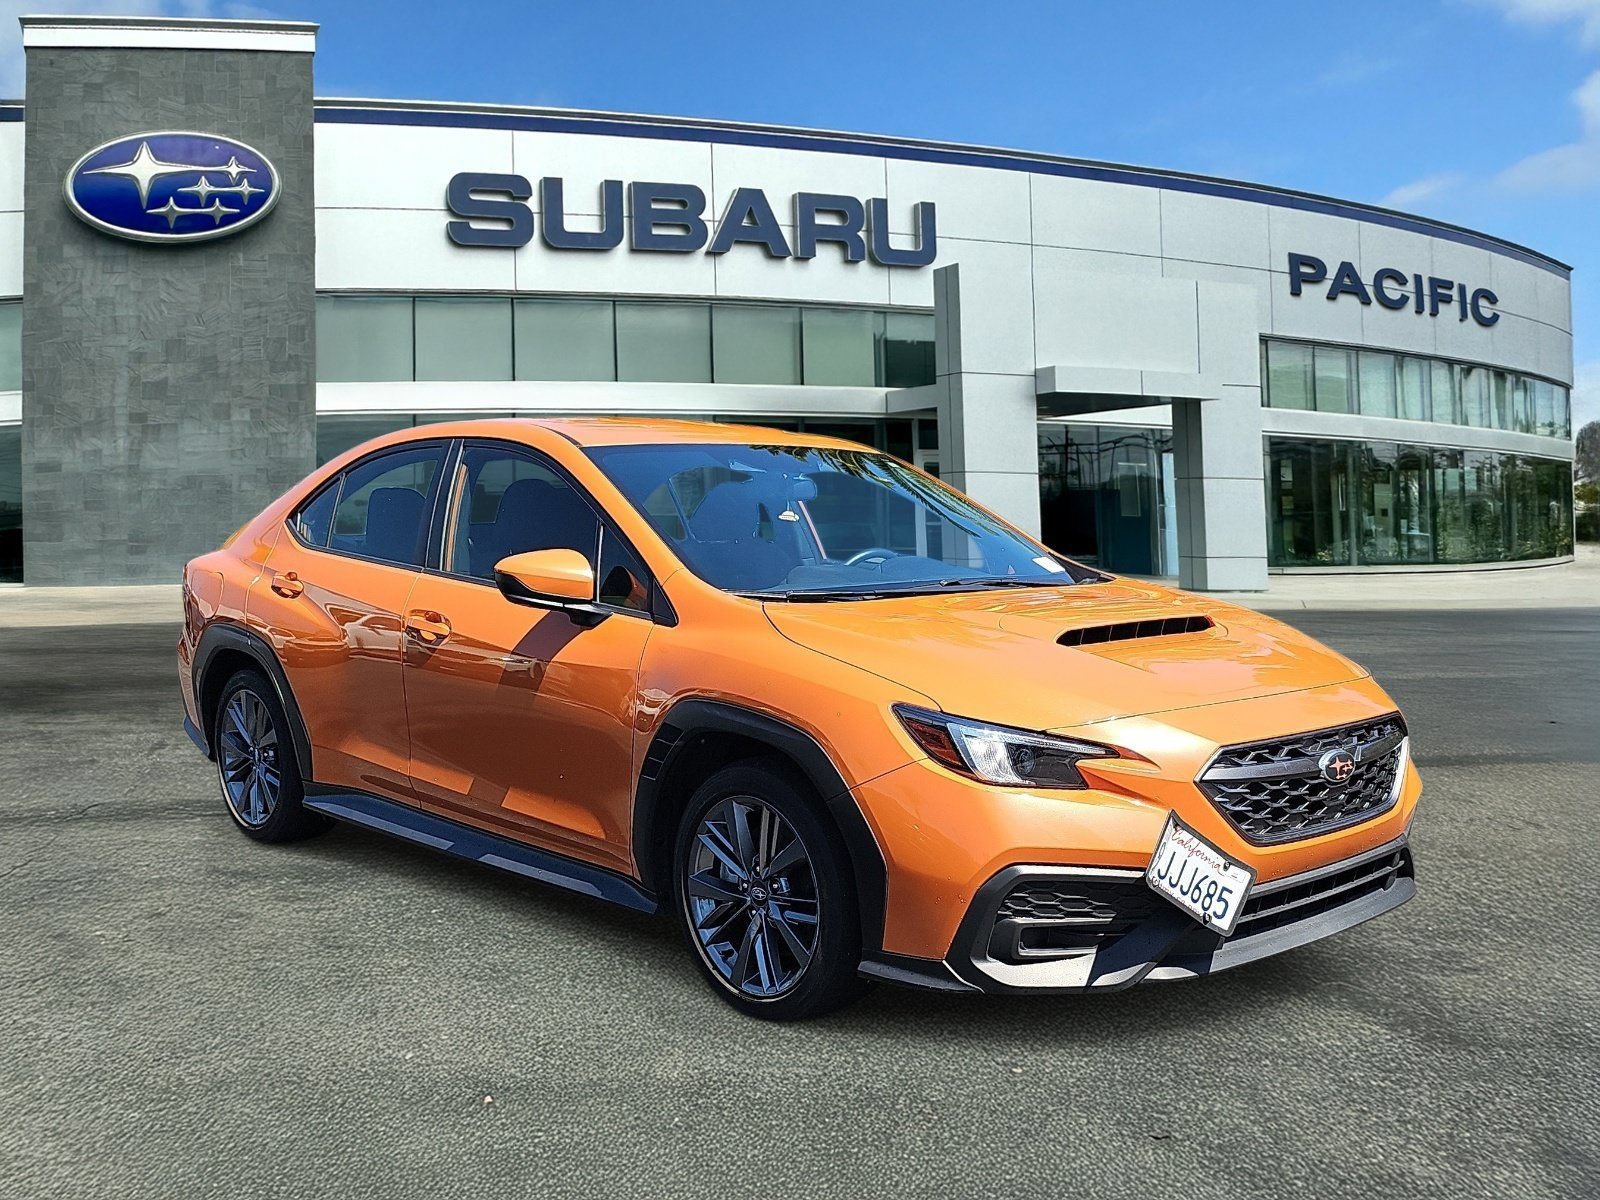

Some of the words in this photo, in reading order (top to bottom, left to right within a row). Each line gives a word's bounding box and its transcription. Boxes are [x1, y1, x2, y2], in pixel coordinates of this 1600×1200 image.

[446, 171, 937, 269] SUBARU
[1288, 252, 1500, 327] PACIFIC
[1157, 851, 1233, 920] JJJ685
[1171, 827, 1225, 877] California
